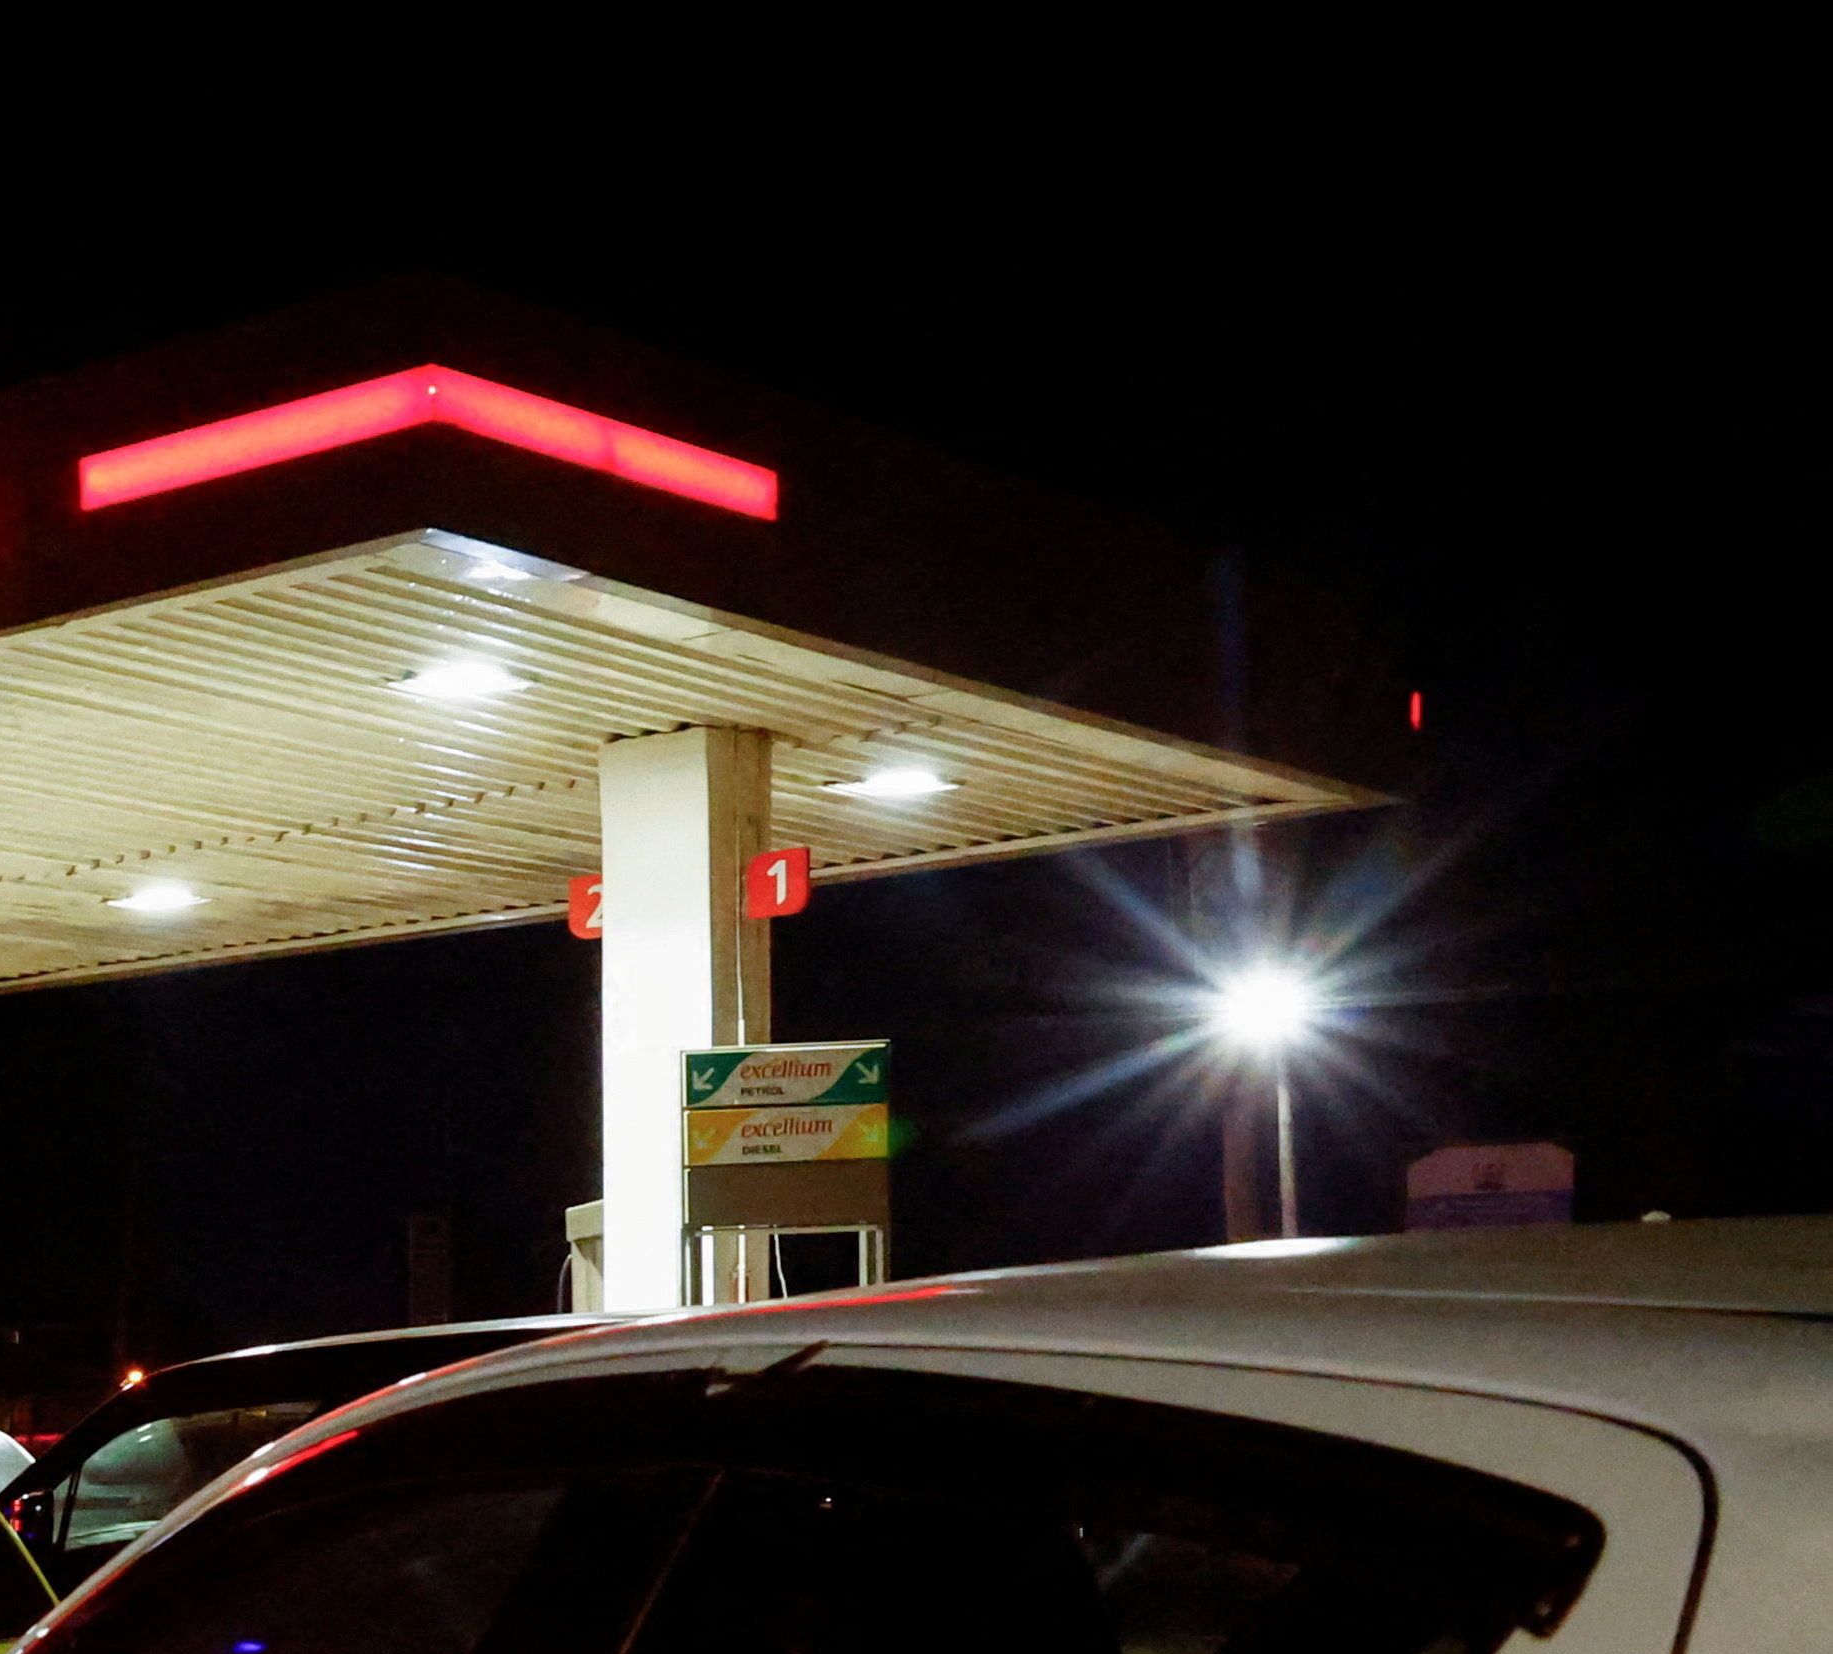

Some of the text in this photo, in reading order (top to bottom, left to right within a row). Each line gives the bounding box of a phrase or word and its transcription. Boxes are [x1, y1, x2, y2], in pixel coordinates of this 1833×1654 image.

[766, 858, 788, 906] 1
[585, 882, 604, 929] 2
[739, 1056, 832, 1081] excellium
[740, 1116, 833, 1140] excellium
